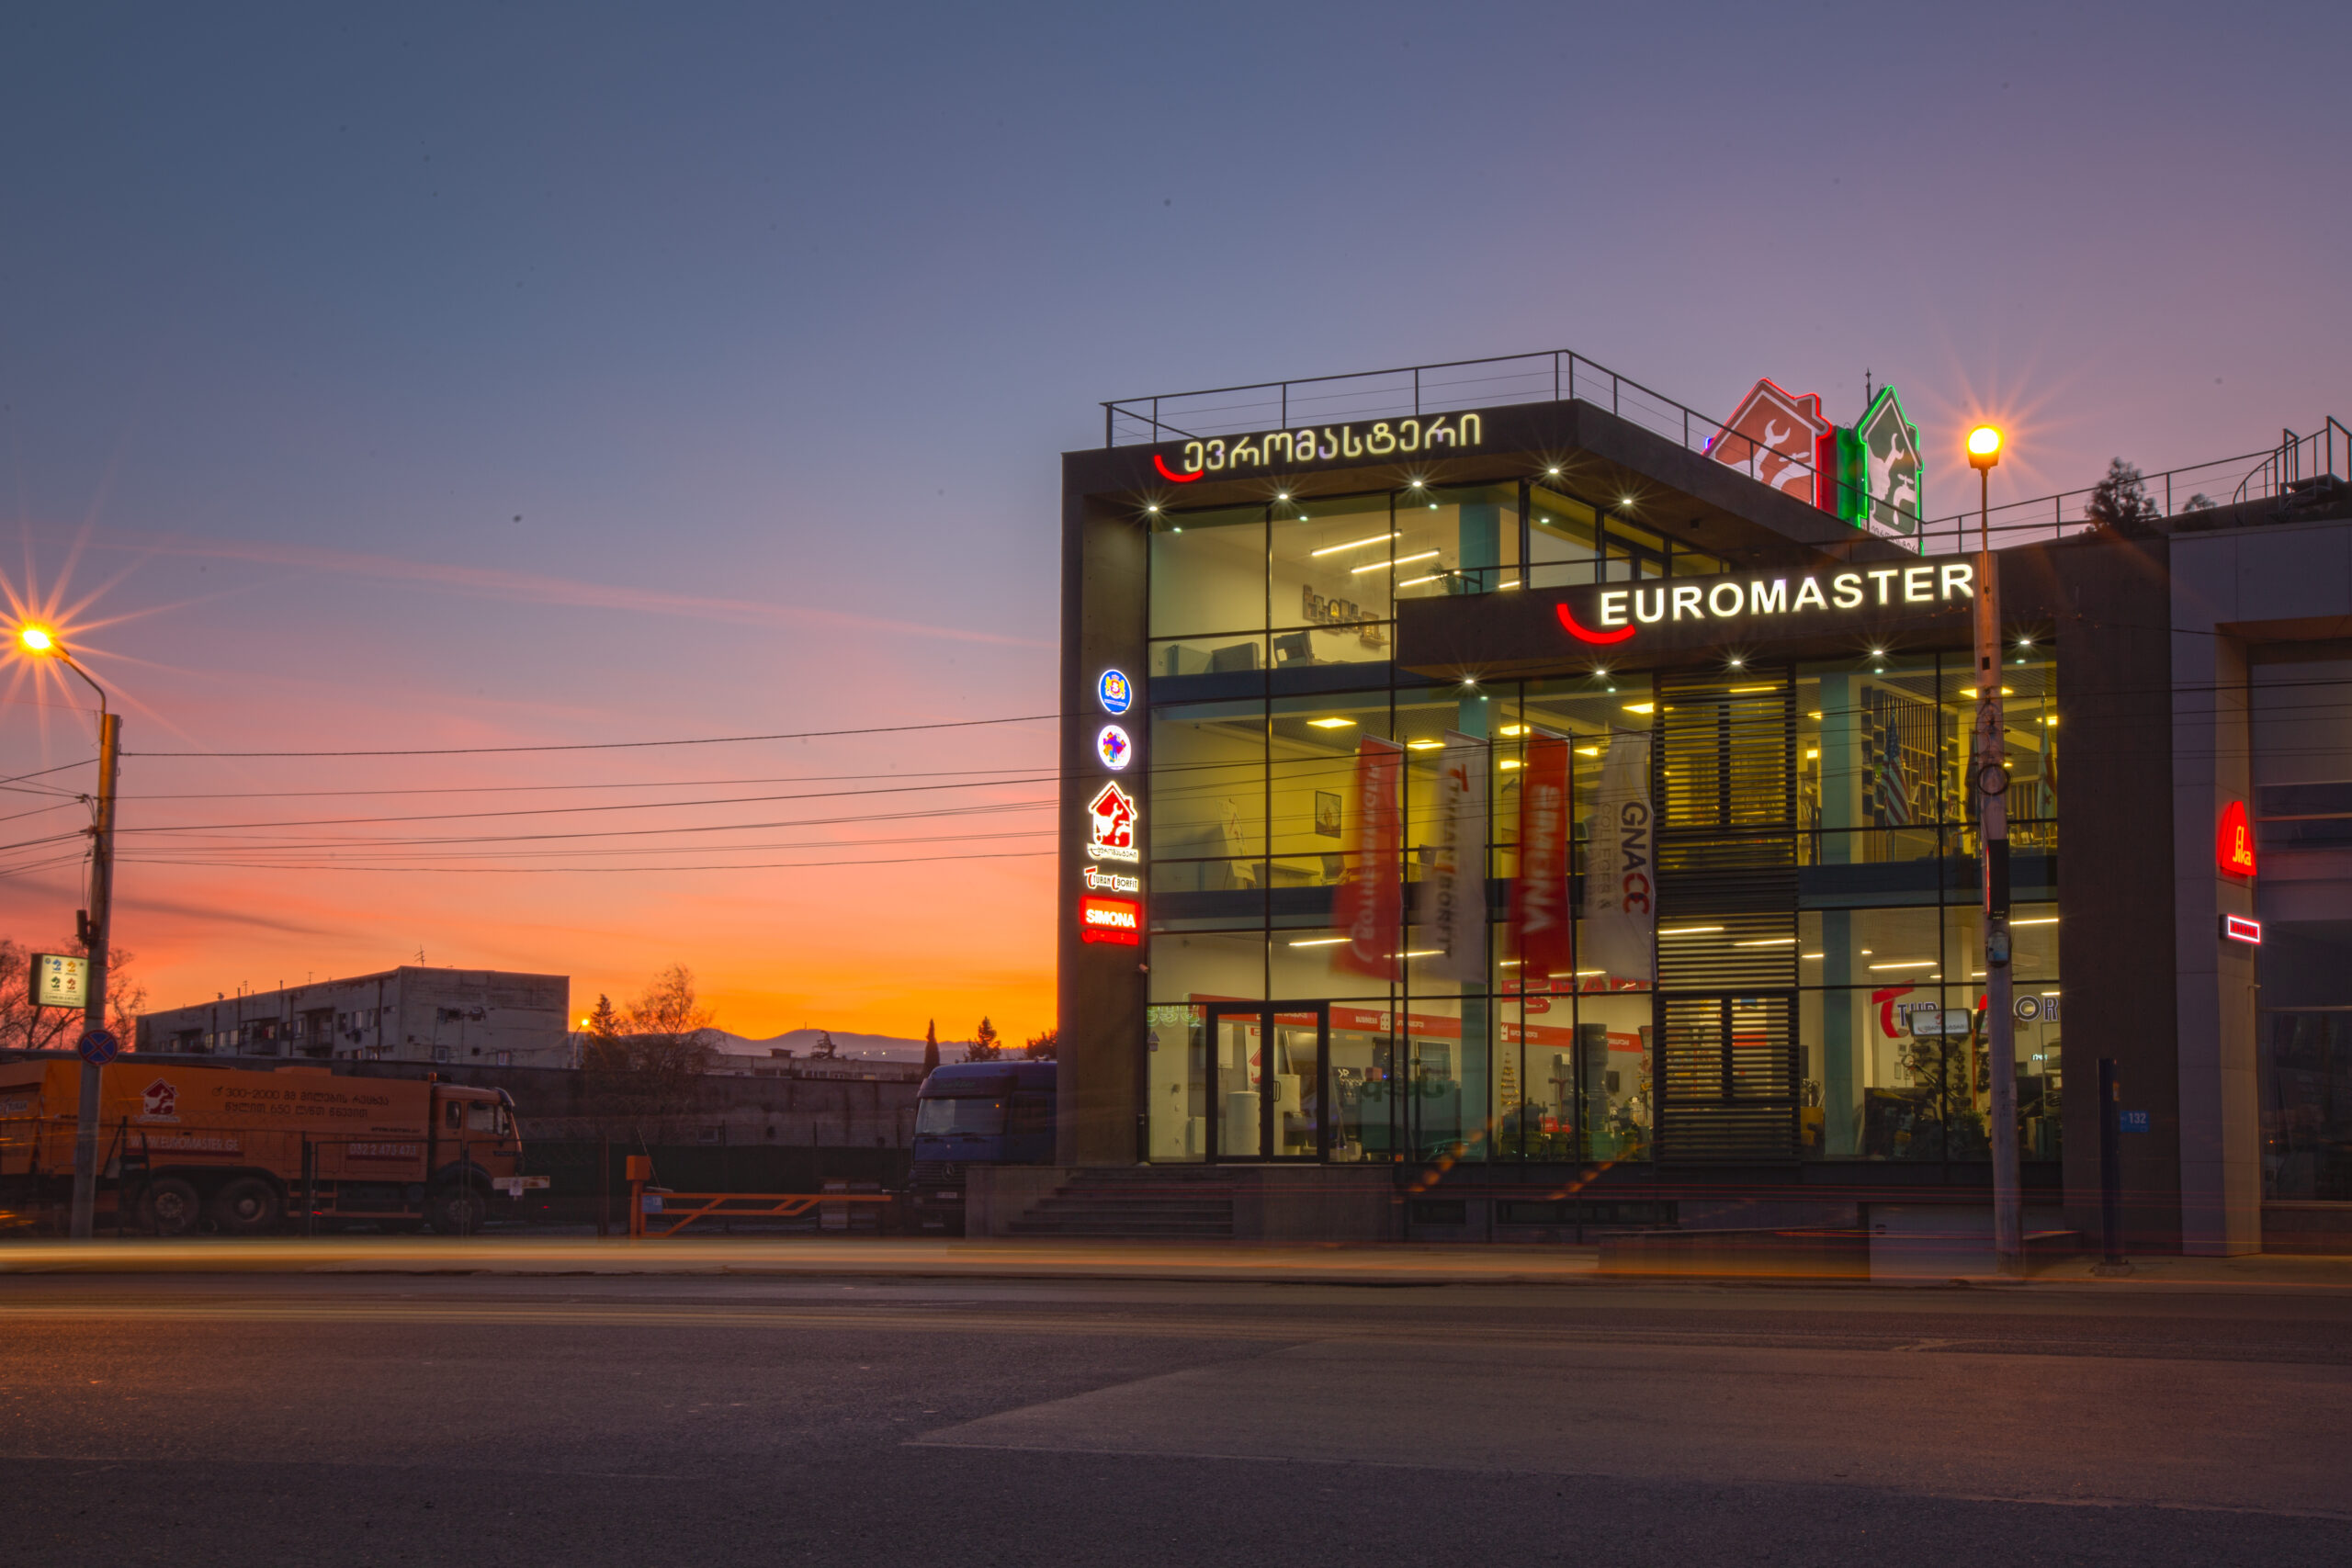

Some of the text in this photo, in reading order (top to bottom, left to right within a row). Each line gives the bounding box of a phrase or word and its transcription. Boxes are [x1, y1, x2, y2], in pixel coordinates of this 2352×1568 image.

[1183, 413, 1482, 473] ევრომასტერი
[1600, 563, 1974, 626] EUROMASTER
[1521, 784, 1561, 933] SIMONA
[1086, 908, 1136, 928] SIMONA
[225, 1088, 280, 1100] 300-2000
[270, 1103, 291, 1114] 650
[2129, 1112, 2146, 1124] 132
